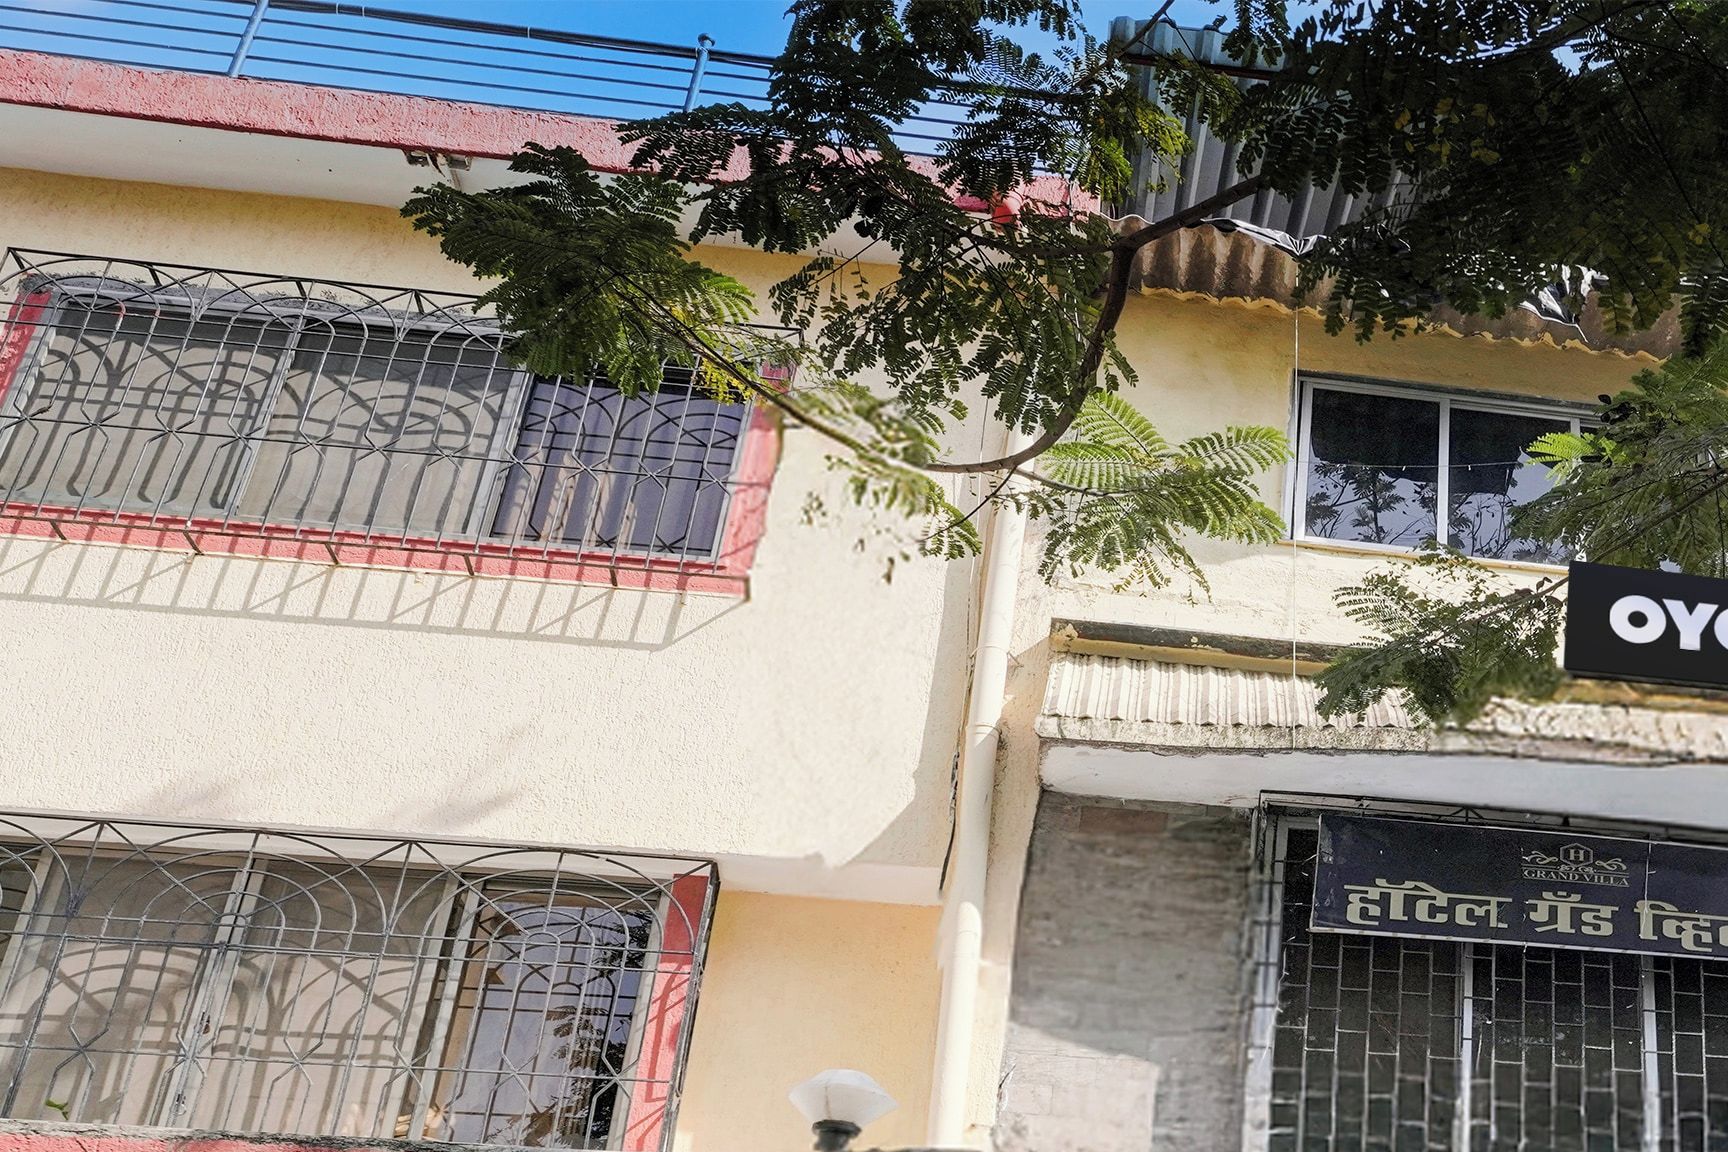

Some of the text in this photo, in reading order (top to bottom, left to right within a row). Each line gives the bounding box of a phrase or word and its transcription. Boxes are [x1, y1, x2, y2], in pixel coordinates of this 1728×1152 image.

[1523, 868, 1630, 886] GRAND VILLA
[1344, 878, 1510, 930] हॉटेल
